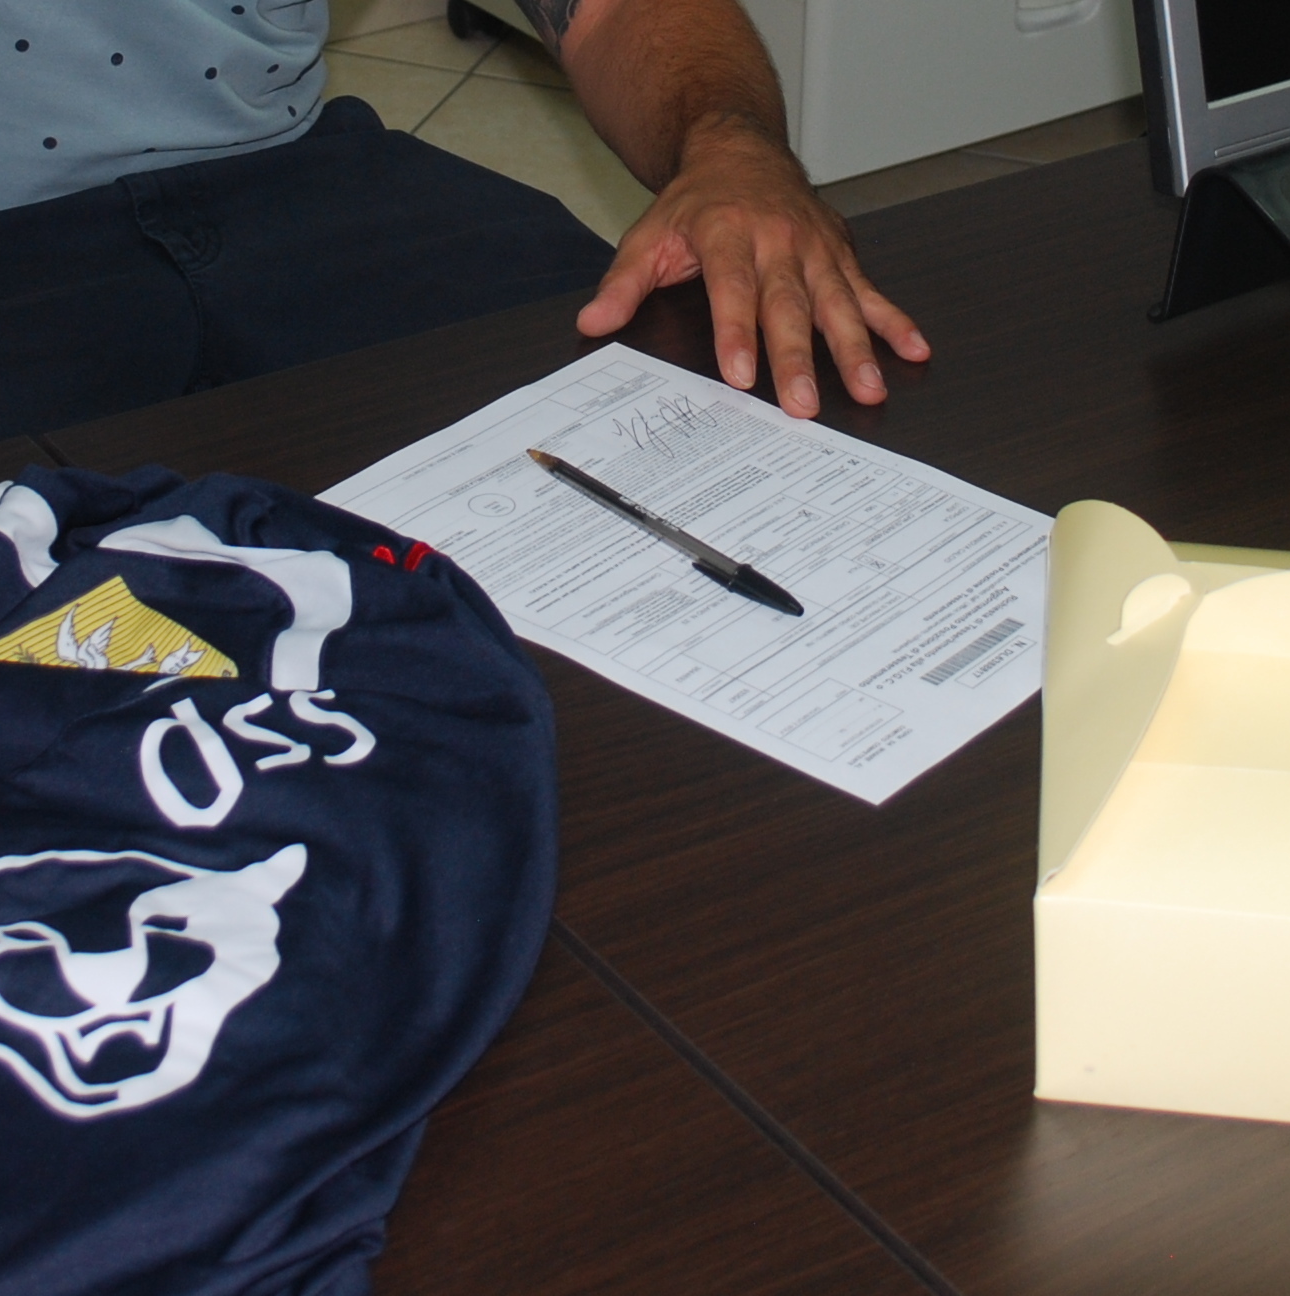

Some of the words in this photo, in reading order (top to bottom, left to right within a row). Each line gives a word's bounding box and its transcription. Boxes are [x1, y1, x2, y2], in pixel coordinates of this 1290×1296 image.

[1005, 534, 1051, 562] ggiornamento
[970, 566, 1005, 588] Posizione
[920, 591, 968, 622] Tesseramento
[950, 585, 1012, 625] Aggiornamento
[978, 593, 1020, 620] Richiesta
[971, 617, 986, 625] di
[916, 622, 957, 648] Posizione
[921, 622, 979, 659] Tesseramento
[907, 656, 927, 668] alla
[908, 646, 922, 654] di
[855, 651, 914, 689] Tesseramento
[880, 665, 913, 686] F.I.G.C.
